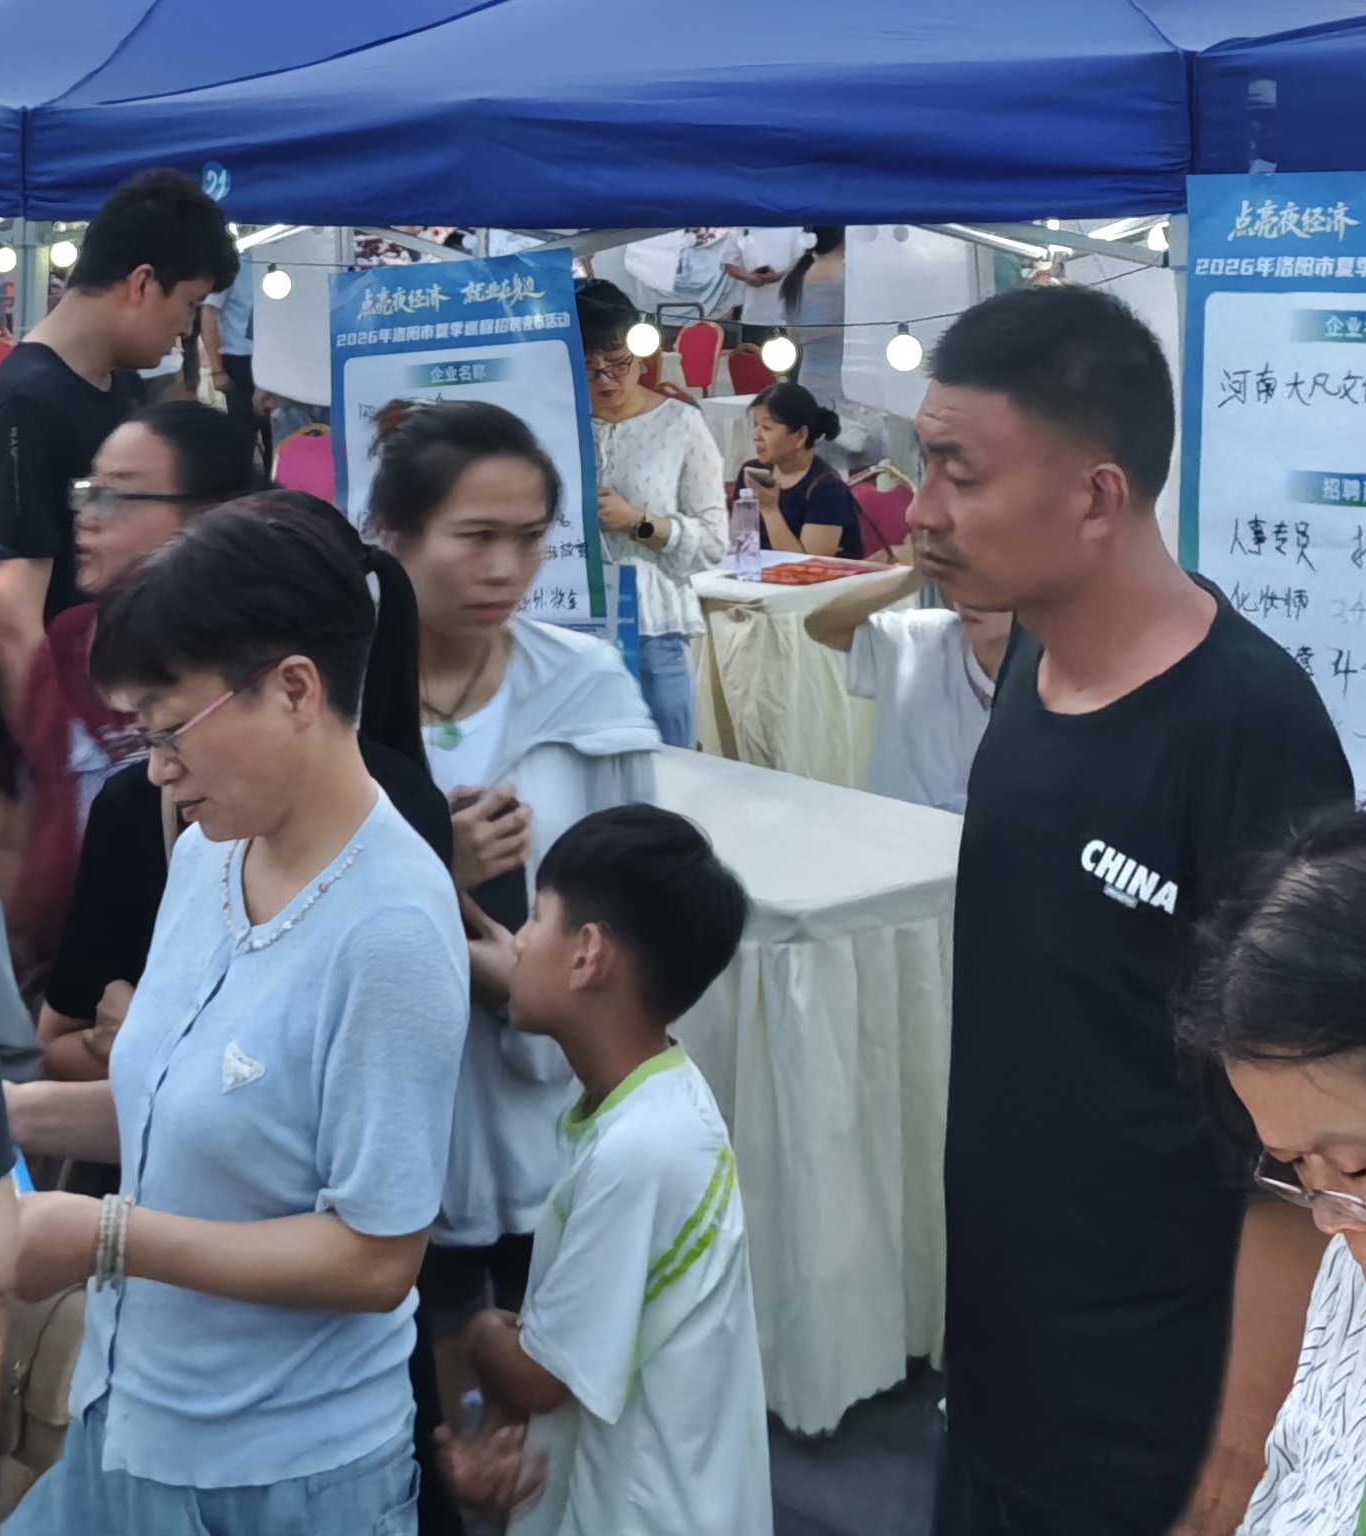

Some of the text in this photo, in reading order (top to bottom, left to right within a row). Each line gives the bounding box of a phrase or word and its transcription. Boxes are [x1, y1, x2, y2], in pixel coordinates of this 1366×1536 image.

[1227, 199, 1361, 243] 点亮夜经济
[357, 283, 451, 321] 点亮夜经济
[1081, 839, 1178, 914] CHINA
